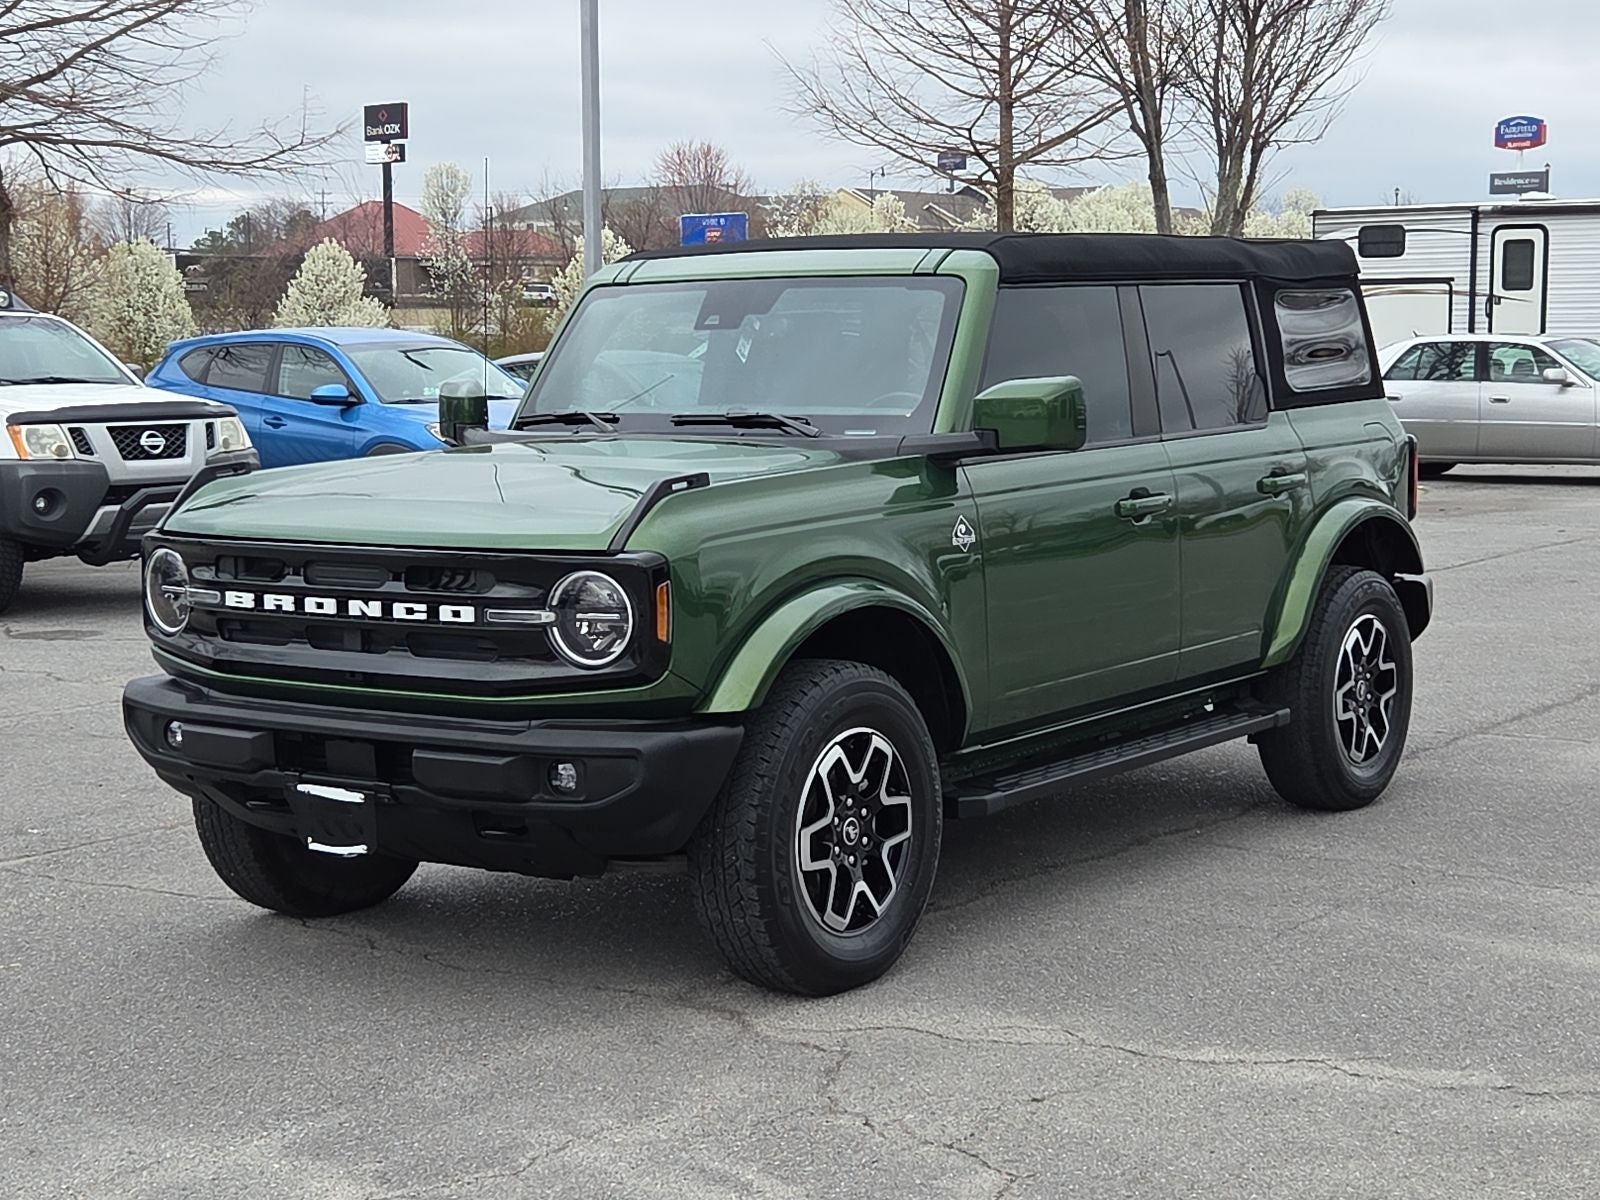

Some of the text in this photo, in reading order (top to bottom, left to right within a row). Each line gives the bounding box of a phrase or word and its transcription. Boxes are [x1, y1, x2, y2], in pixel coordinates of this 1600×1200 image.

[366, 123, 401, 136] Bank OZK
[1500, 124, 1538, 135] FAIRFIELD
[224, 590, 475, 623] BRONCO
